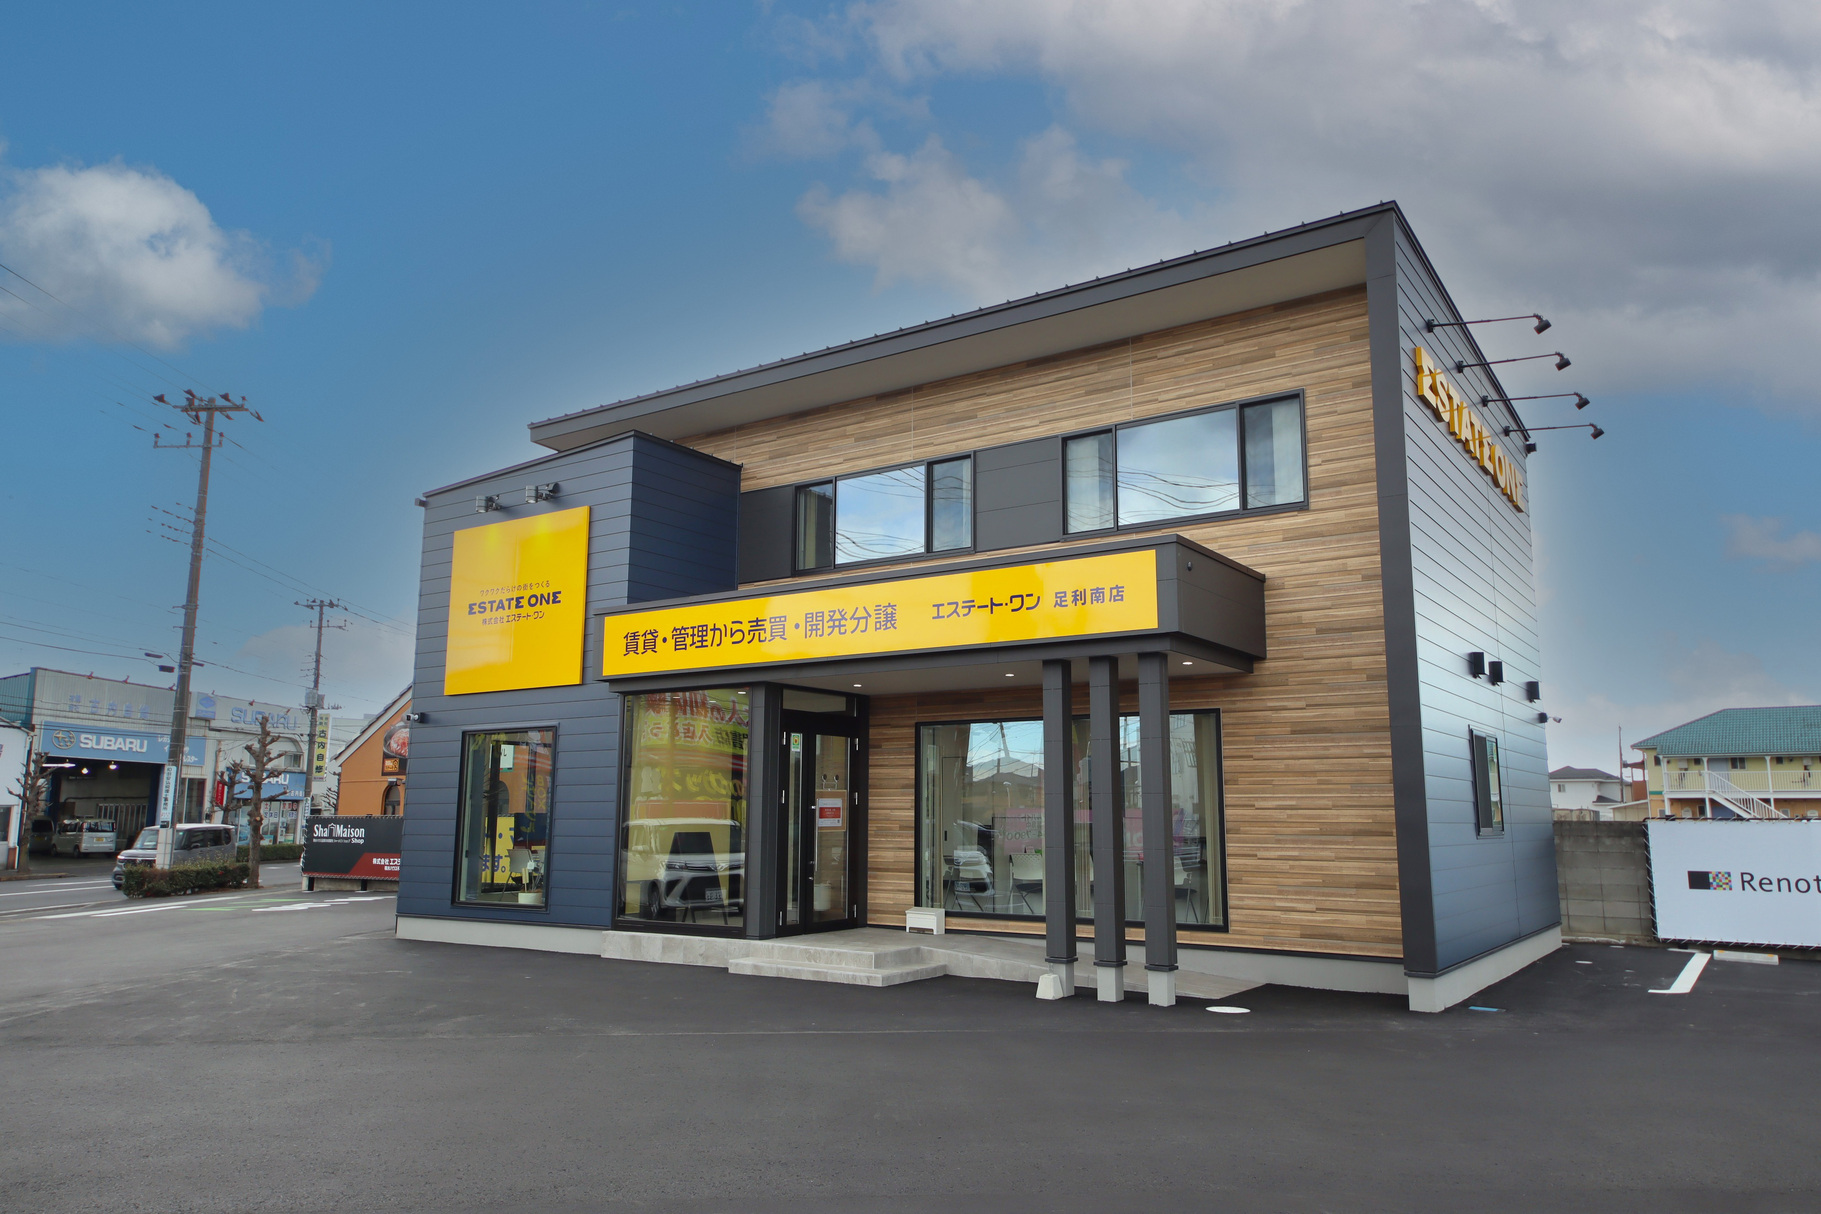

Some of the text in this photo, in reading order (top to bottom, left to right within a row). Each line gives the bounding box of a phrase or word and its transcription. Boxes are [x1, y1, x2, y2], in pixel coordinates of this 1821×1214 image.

[1415, 346, 1525, 513] ESTATE ONE
[467, 590, 562, 616] ESTATE ONE
[1053, 584, 1125, 609] 足利南店
[481, 616, 505, 626] 株式会社
[623, 602, 898, 657] 賃貸・管理から売買・開発分譲
[79, 734, 148, 753] SUBARU
[350, 837, 365, 845] Shop
